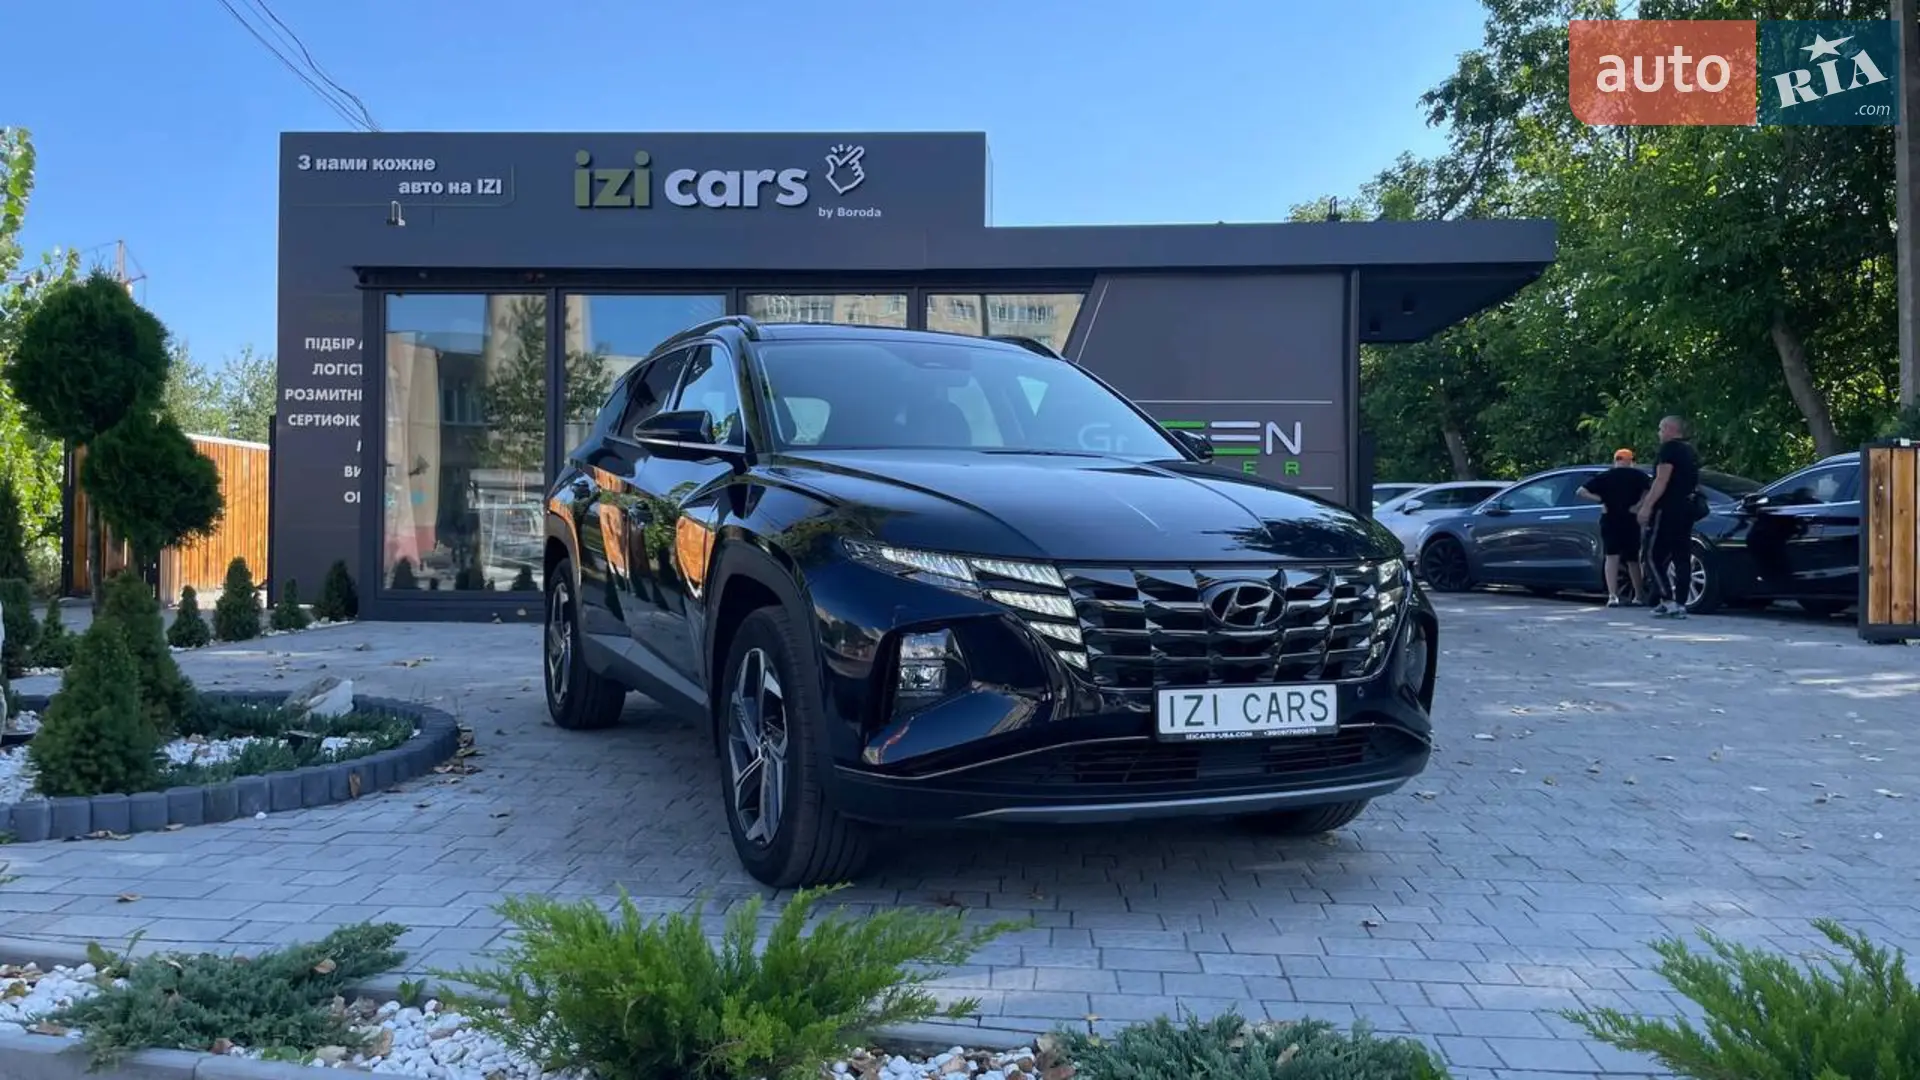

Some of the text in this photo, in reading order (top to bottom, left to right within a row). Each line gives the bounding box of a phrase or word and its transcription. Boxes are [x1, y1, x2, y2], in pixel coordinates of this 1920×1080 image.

[297, 154, 437, 171] З нами кожне
[574, 150, 809, 207] izi cars
[398, 178, 502, 195] авто на IZI
[818, 207, 882, 218] by Boroda
[305, 337, 355, 351] ПІДБІР
[312, 363, 363, 375] ЛОГІСТ
[288, 414, 361, 427] СЕРТИФІК
[1169, 689, 1330, 728] IZI CARS
